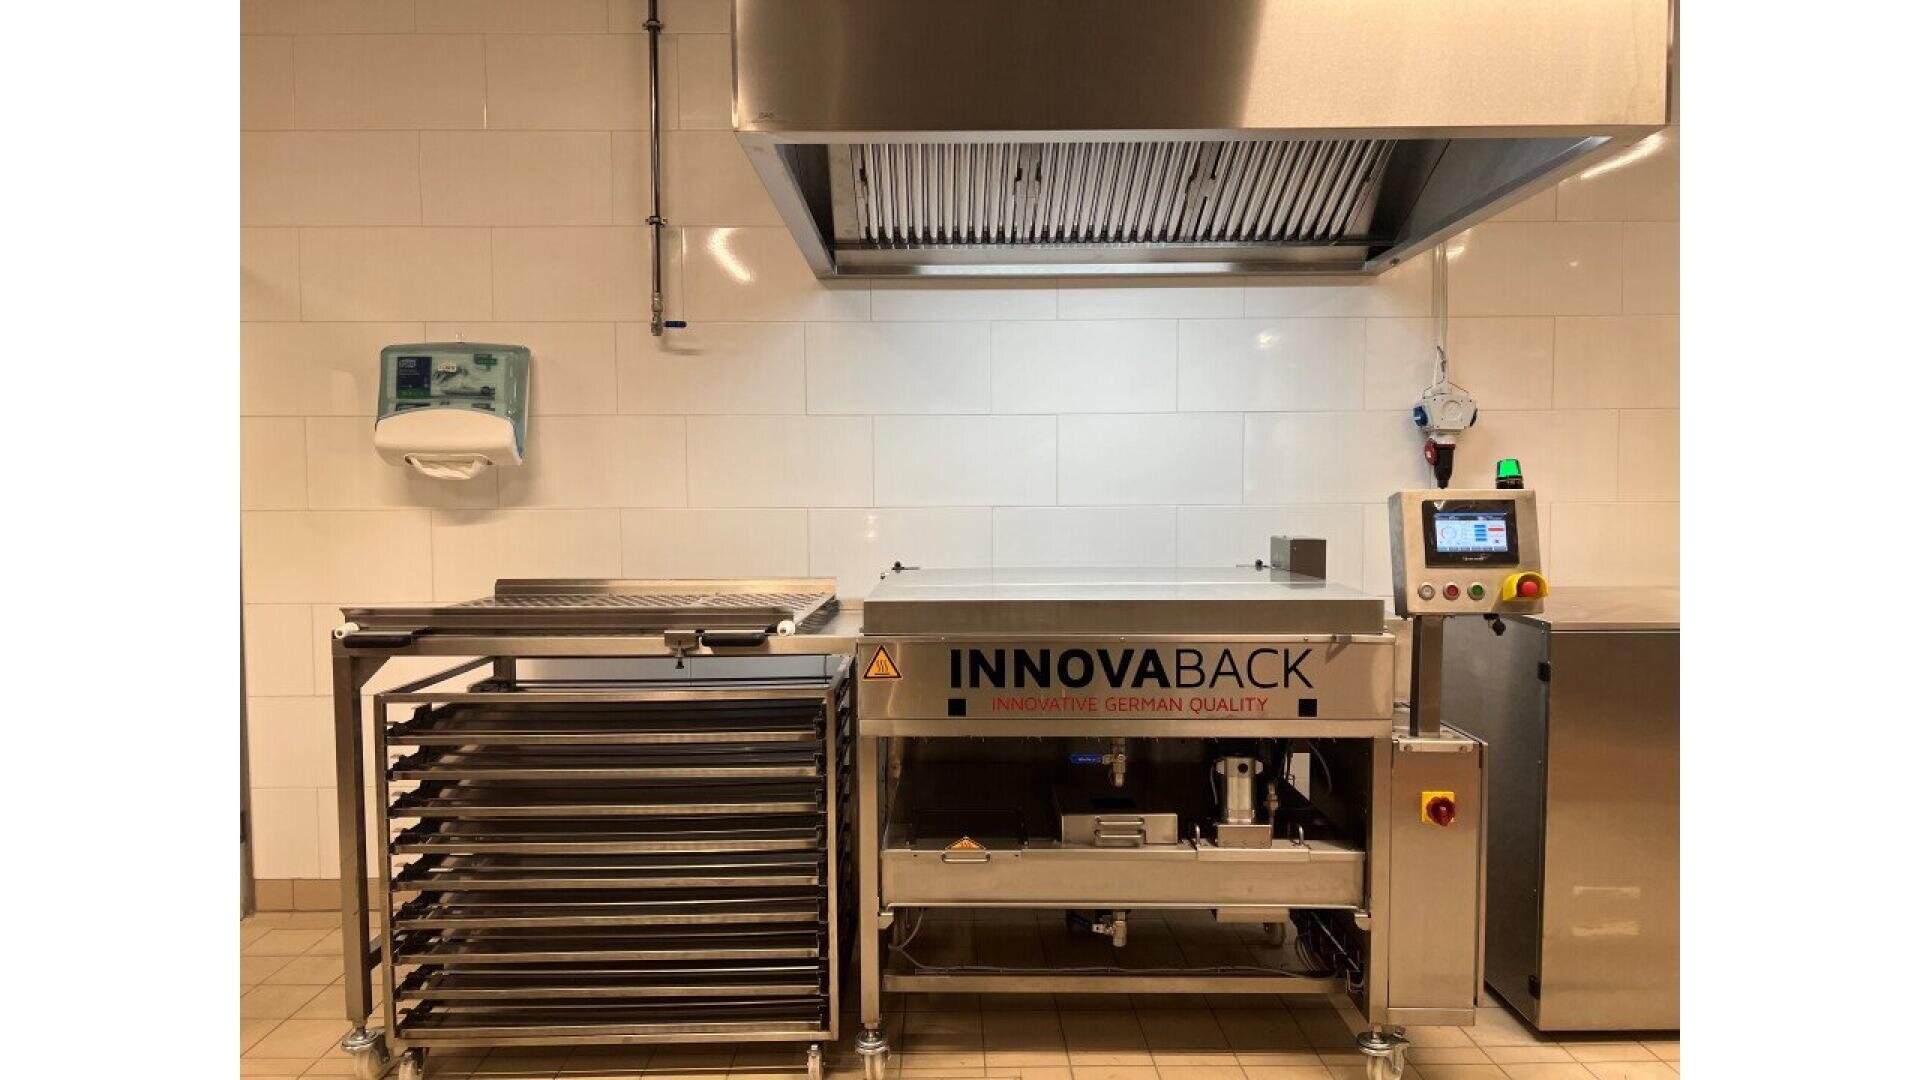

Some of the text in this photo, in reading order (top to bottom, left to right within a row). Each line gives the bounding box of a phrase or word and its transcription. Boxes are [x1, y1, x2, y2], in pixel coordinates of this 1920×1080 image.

[950, 648, 1314, 688] INNOVABACK
[992, 697, 1268, 714] INNOVATIVE GERMAN QUALITY
